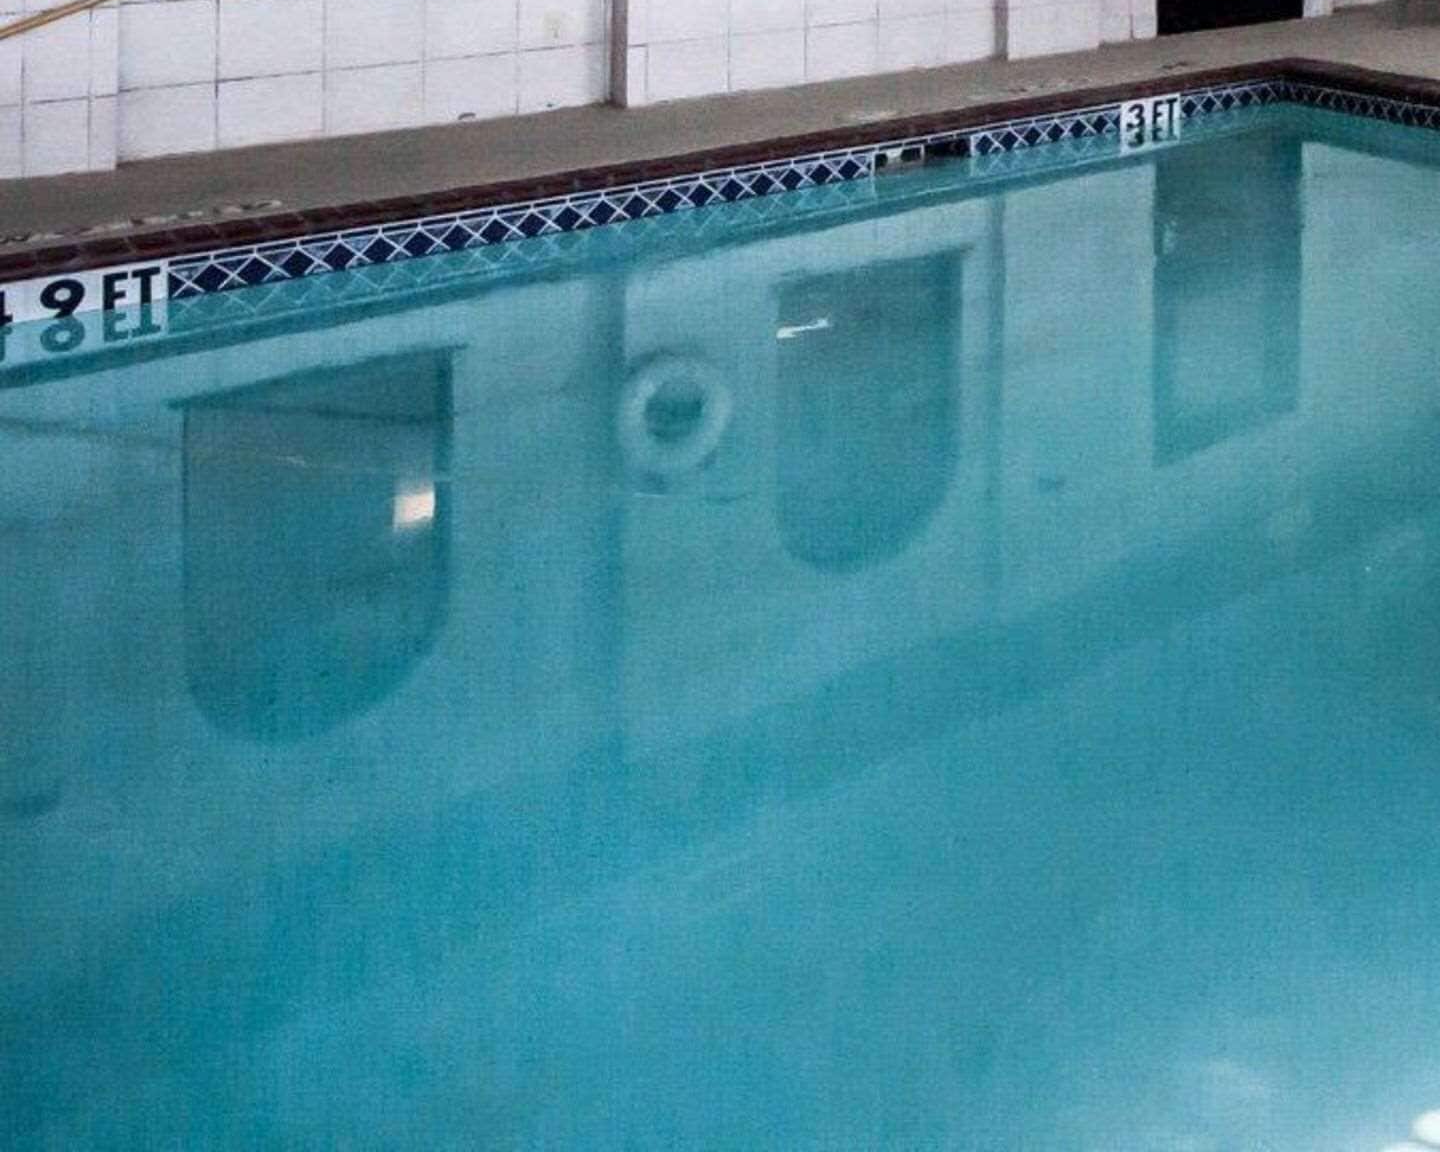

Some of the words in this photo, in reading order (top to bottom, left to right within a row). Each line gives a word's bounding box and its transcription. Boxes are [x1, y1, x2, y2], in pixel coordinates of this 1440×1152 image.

[1126, 103, 1145, 129] 3
[1152, 98, 1178, 126] FT
[103, 266, 161, 311] FT
